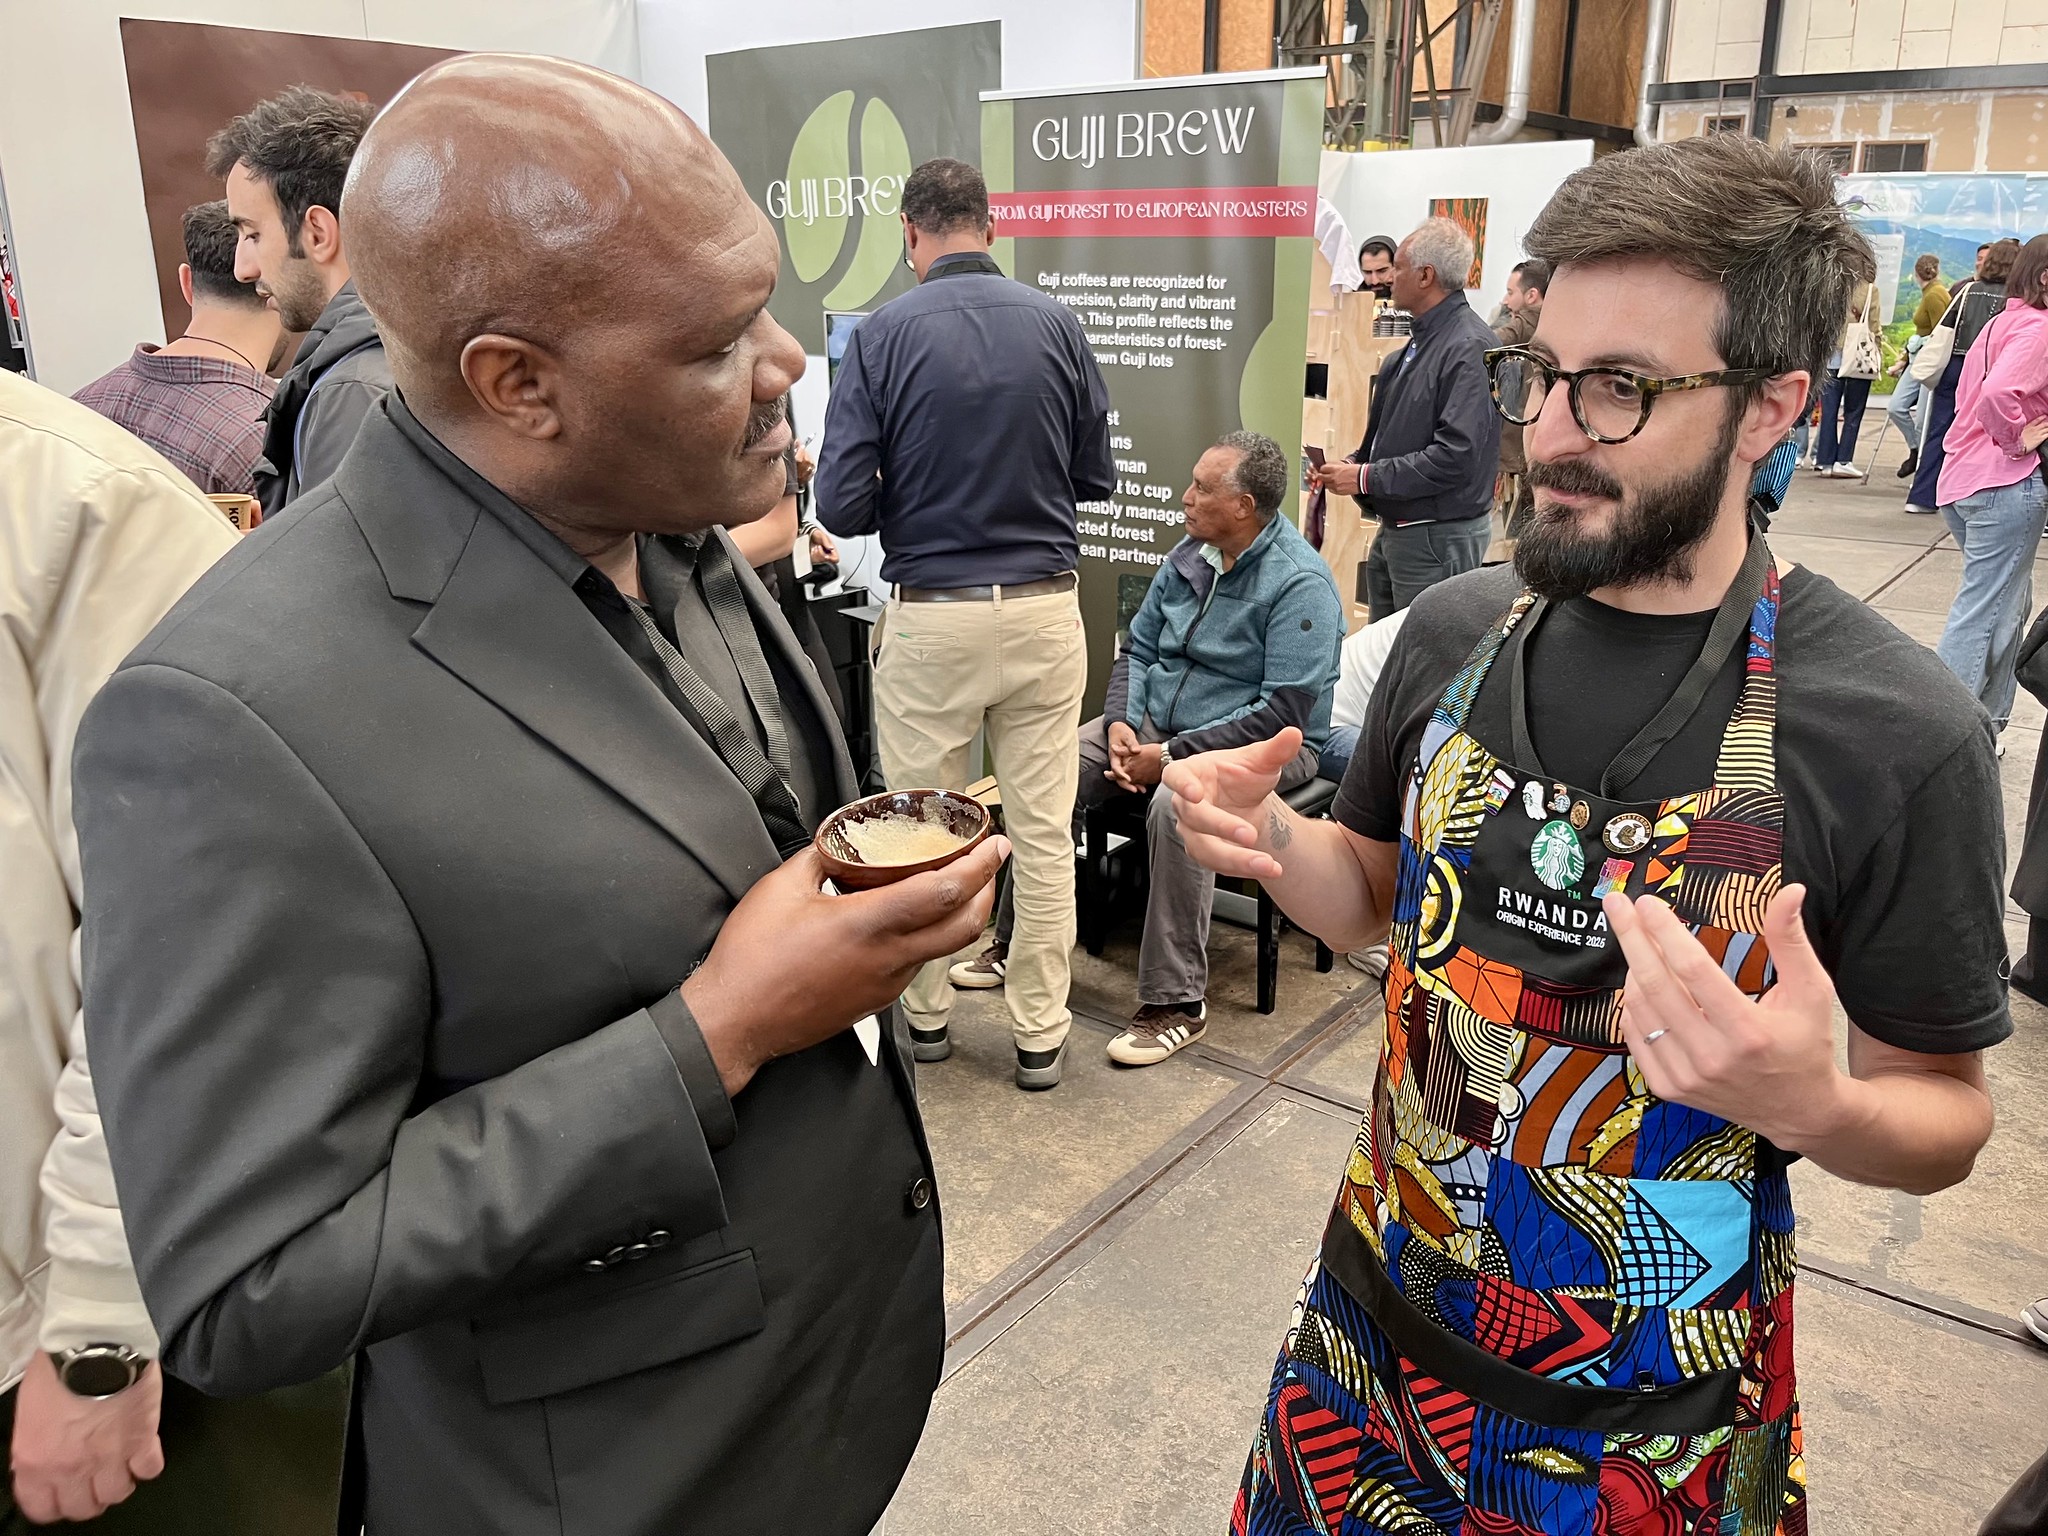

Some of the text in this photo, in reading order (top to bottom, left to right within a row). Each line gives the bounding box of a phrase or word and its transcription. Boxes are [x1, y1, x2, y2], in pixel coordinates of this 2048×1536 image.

[1032, 107, 1255, 169] GUJI BREW
[766, 179, 819, 226] GUJI
[988, 205, 1026, 220] FROM
[1053, 204, 1110, 219] FOREST
[1113, 203, 1133, 219] TO
[1136, 202, 1220, 218] EUROPEAN
[1223, 200, 1308, 218] ROASTERS
[1038, 273, 1227, 291] Guji coffees are recognized for
[1119, 294, 1156, 311] clarity
[1160, 295, 1186, 309] and
[1189, 295, 1236, 310] vibrant
[1087, 312, 1113, 326] This
[1116, 314, 1156, 329] profile
[1159, 315, 1207, 331] reflects
[1210, 316, 1233, 331] the
[1167, 334, 1182, 348] of
[1184, 335, 1227, 350] forest-
[1120, 353, 1146, 369] Guji
[1148, 353, 1174, 368] lots
[1125, 480, 1141, 496] to
[1144, 486, 1172, 502] cup
[1126, 506, 1186, 527] manage
[1076, 520, 1155, 543] cted forest
[1080, 543, 1106, 559] ean
[1567, 889, 1581, 900] TM
[1498, 886, 1608, 932] RWANDA
[1496, 910, 1606, 948] ORIGIN EXPERIENCE 2025
